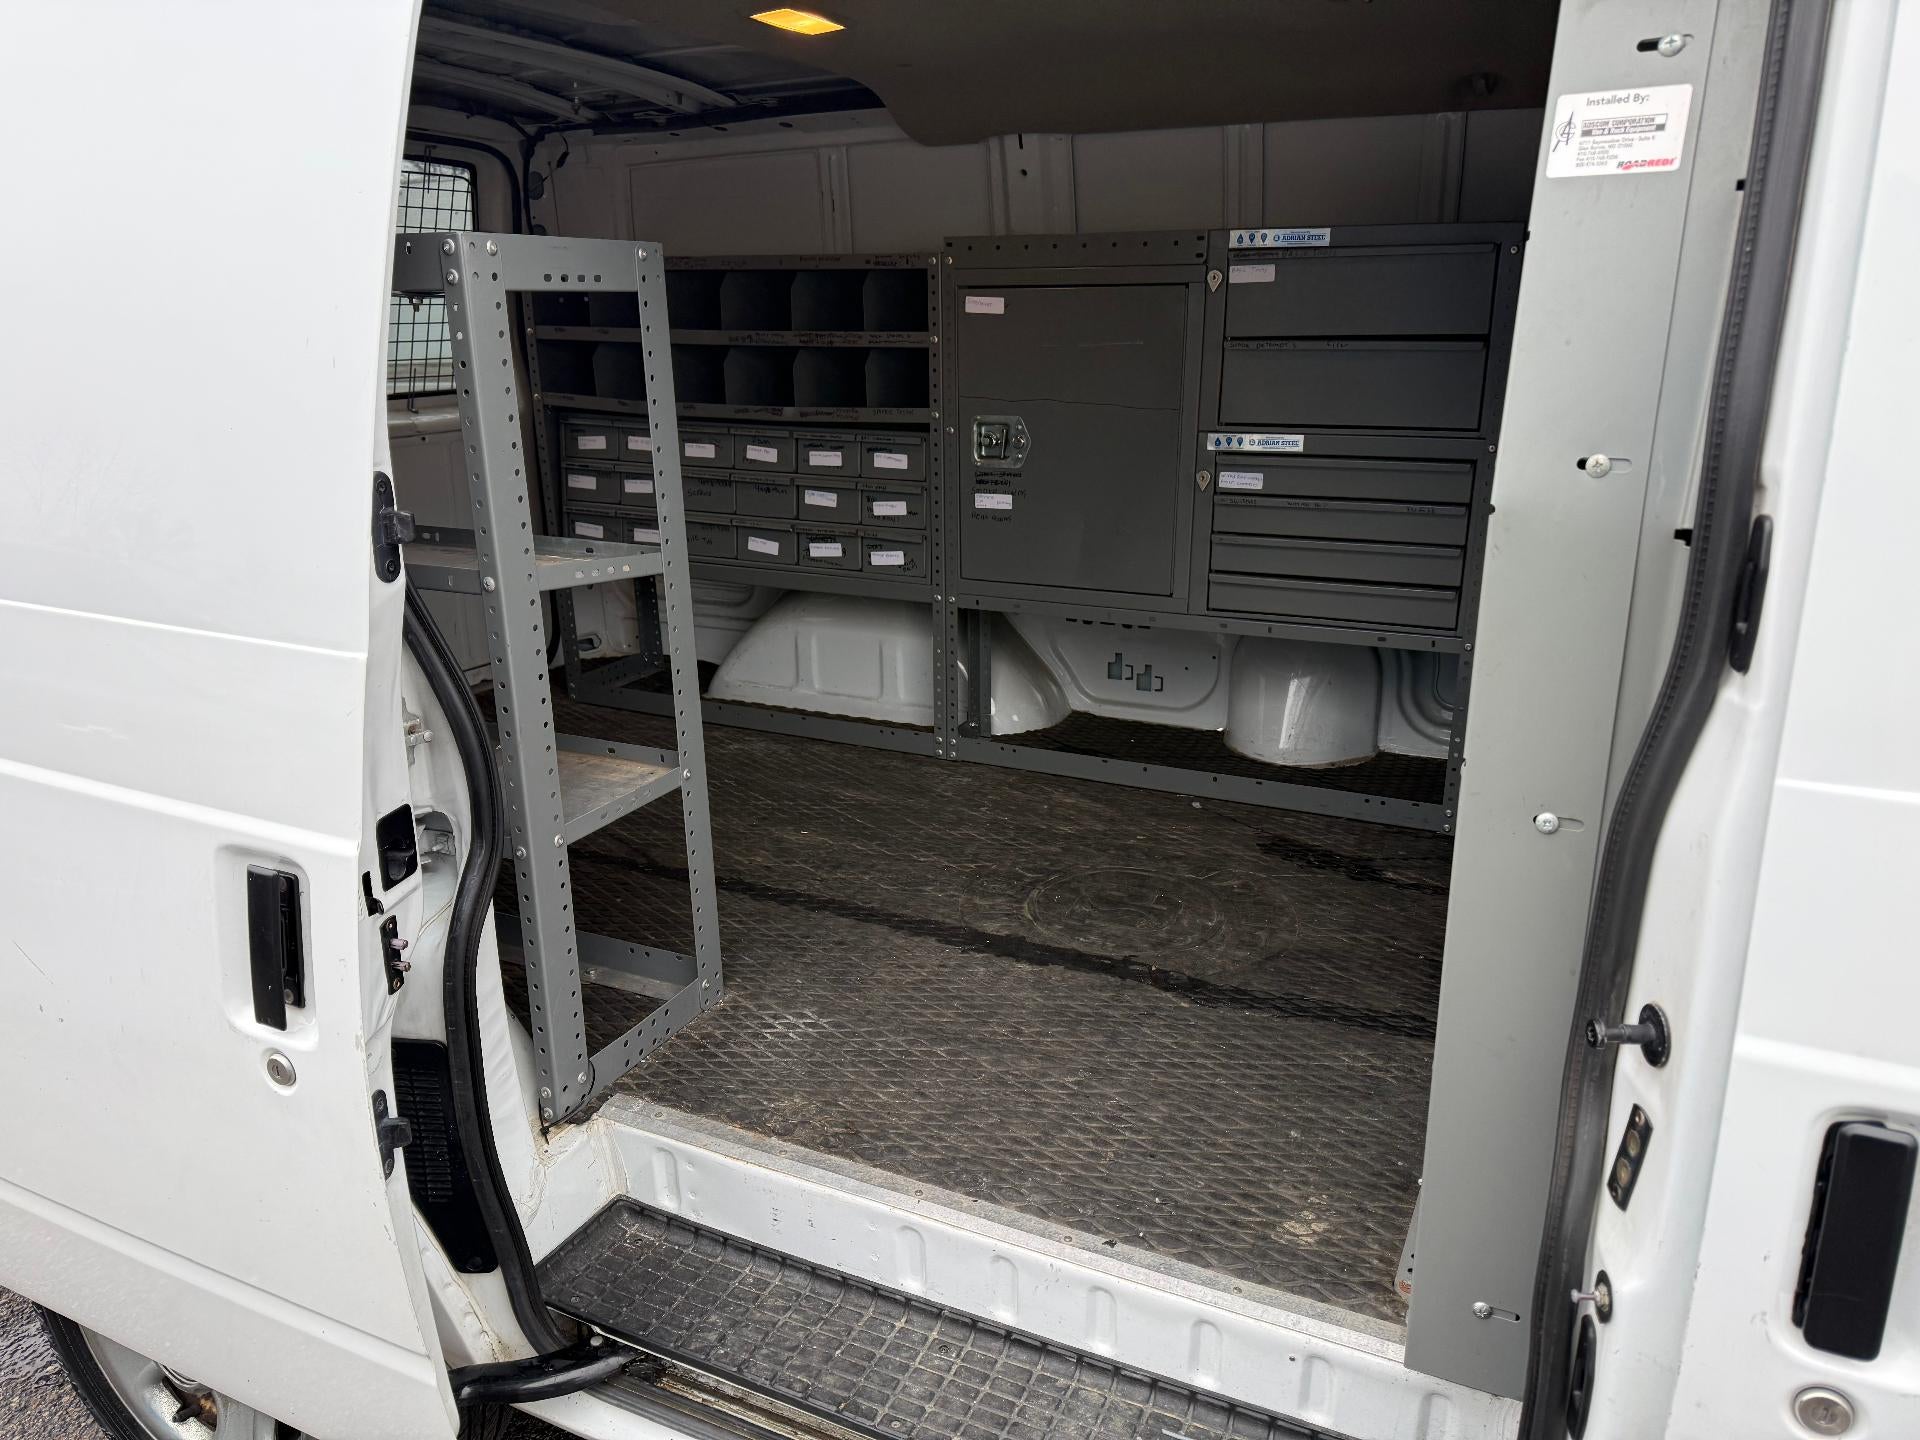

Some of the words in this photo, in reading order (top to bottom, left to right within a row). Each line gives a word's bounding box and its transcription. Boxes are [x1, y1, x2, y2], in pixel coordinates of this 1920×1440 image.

[1586, 94, 1630, 106] Installed
[1633, 93, 1650, 105] By:
[1612, 117, 1655, 127] CORPORATION
[1281, 234, 1306, 242] ADRIAN
[1256, 439, 1280, 447] ADRIAN
